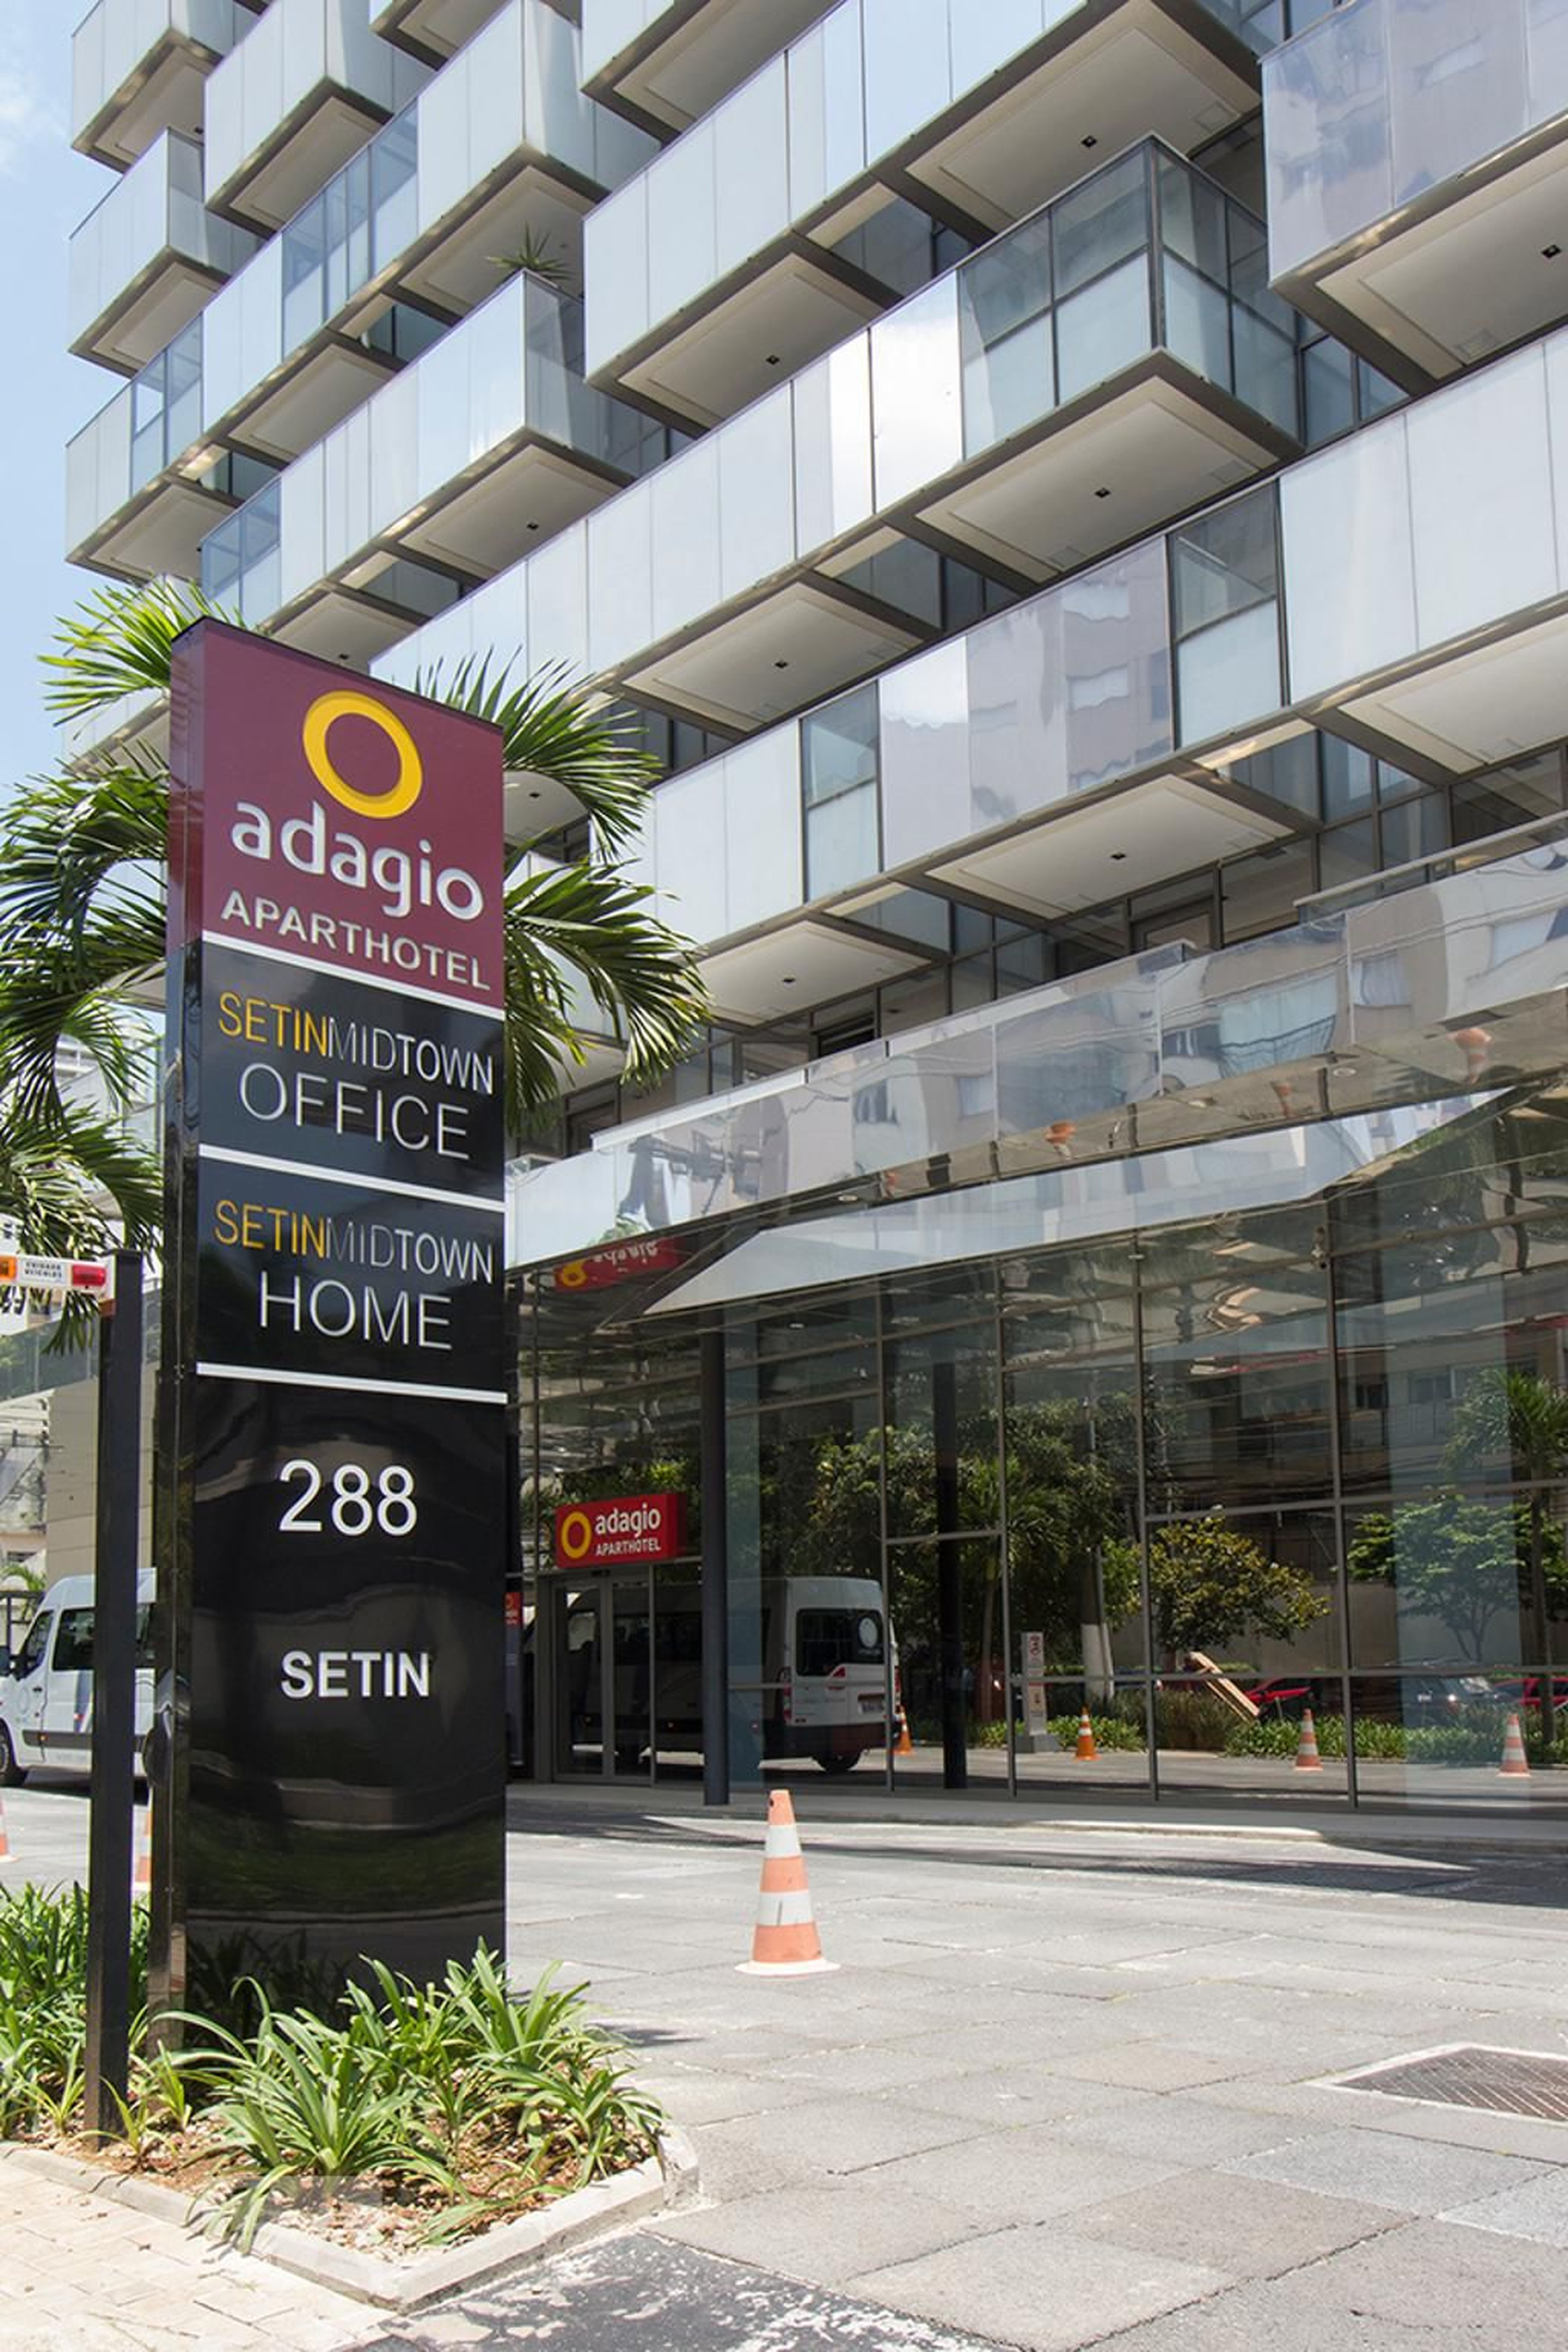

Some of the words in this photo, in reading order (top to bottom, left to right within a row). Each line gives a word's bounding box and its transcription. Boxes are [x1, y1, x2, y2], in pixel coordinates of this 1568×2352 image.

[231, 800, 483, 920] adagio
[220, 890, 491, 991] APARTHOTEL
[239, 1062, 470, 1160] OFFICE
[260, 1271, 452, 1350] HOME
[278, 1459, 417, 1536] 288
[595, 1502, 661, 1538] adagio
[595, 1537, 662, 1557] APARTHOTEL
[281, 1650, 430, 1699] SETIN
